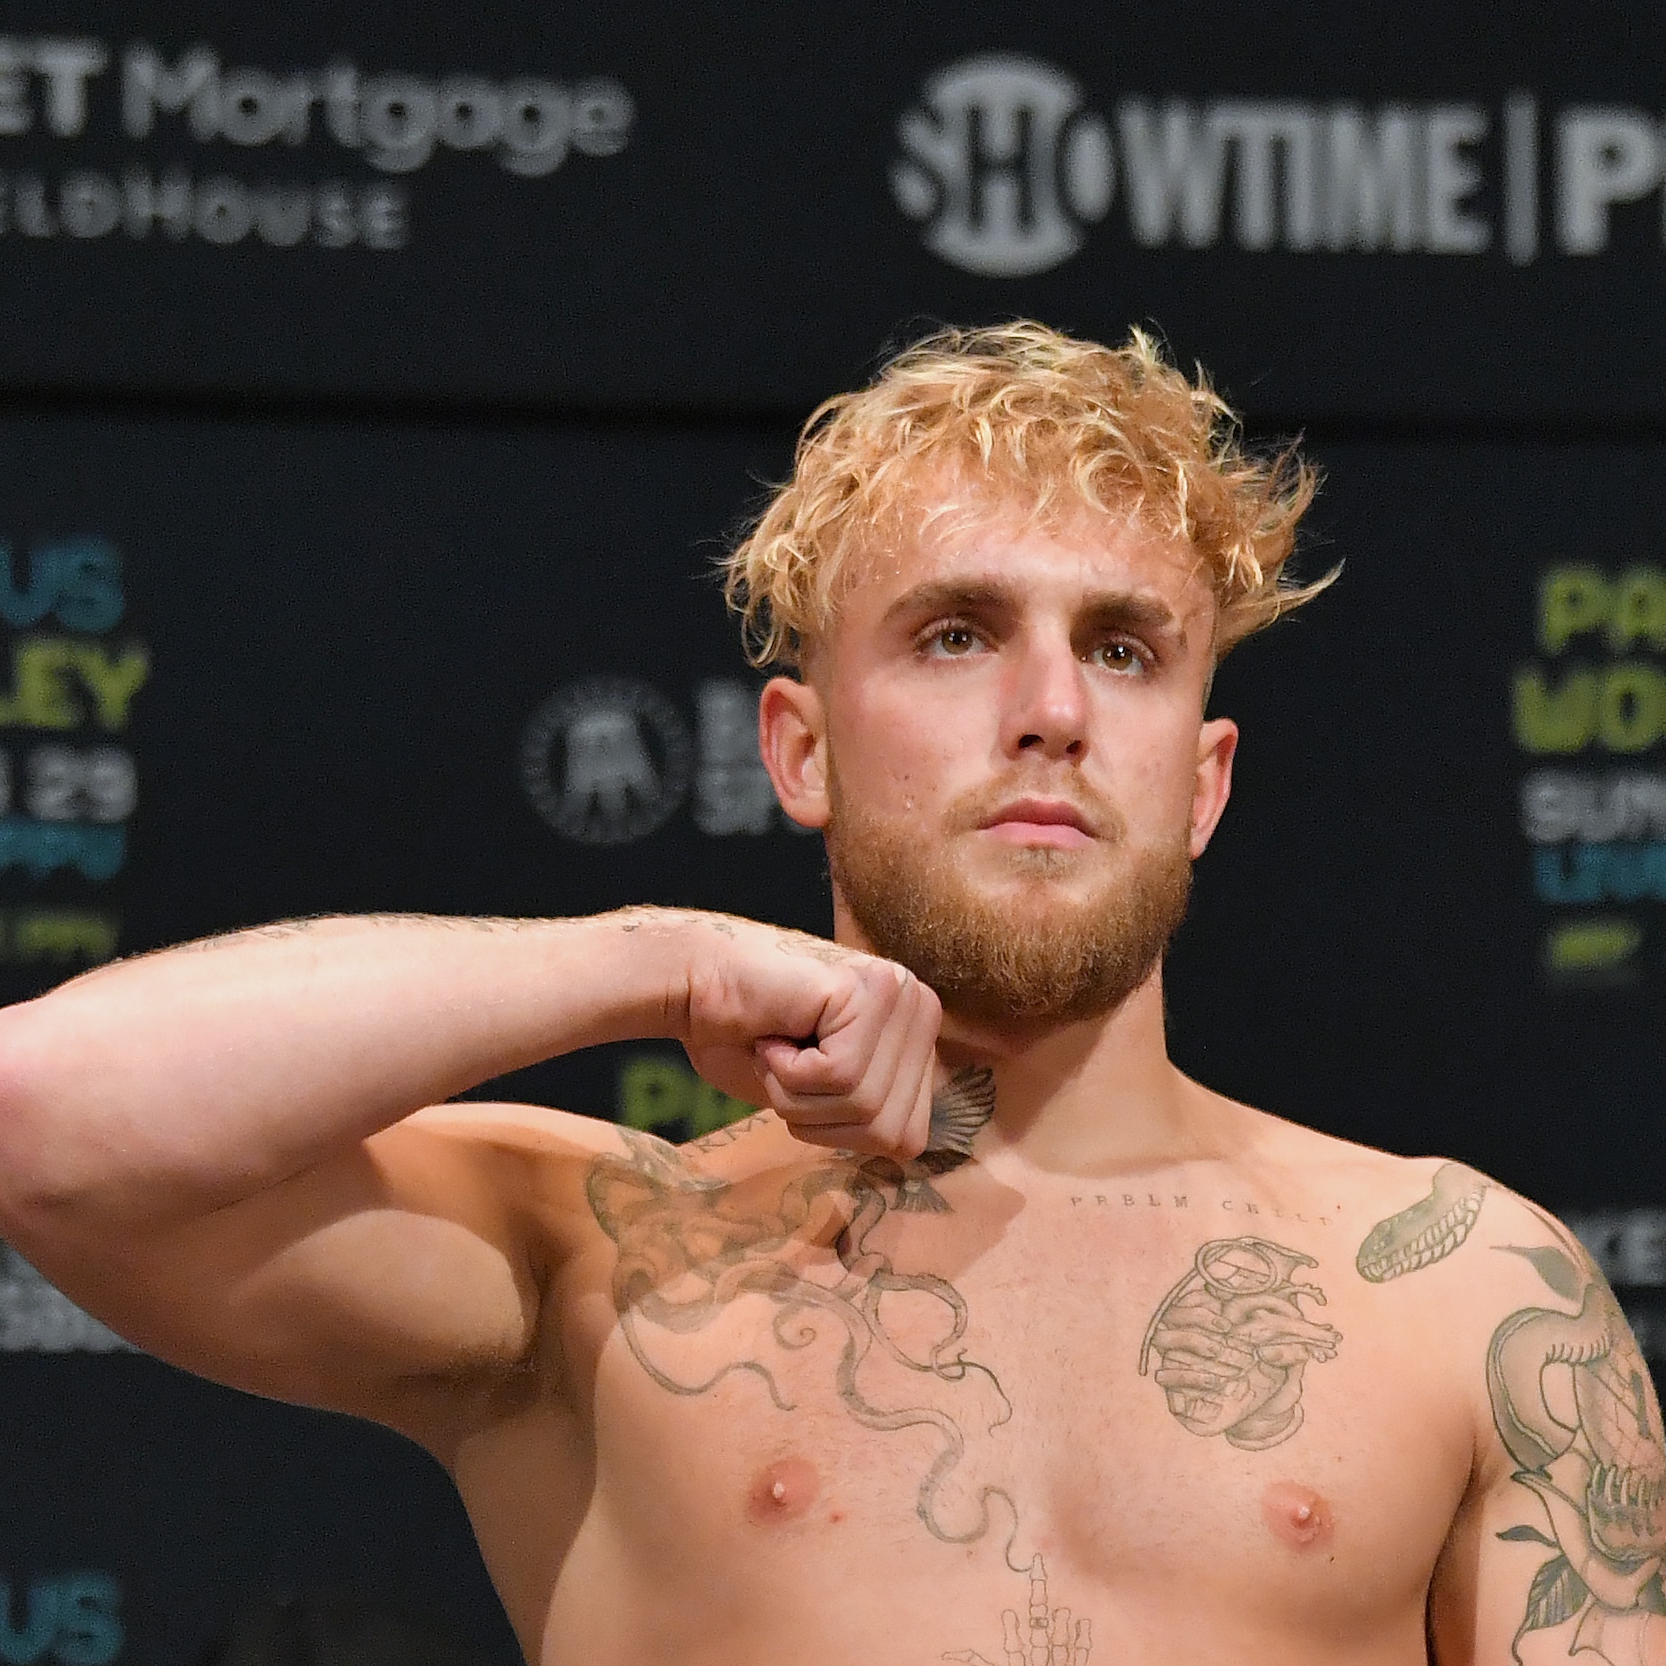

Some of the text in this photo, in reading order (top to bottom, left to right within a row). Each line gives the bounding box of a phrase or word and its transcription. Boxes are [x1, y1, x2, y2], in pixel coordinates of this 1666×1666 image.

[121, 38, 635, 176] Mortgage
[887, 48, 1493, 280] SHOWTIME
[25, 742, 138, 824] 29
